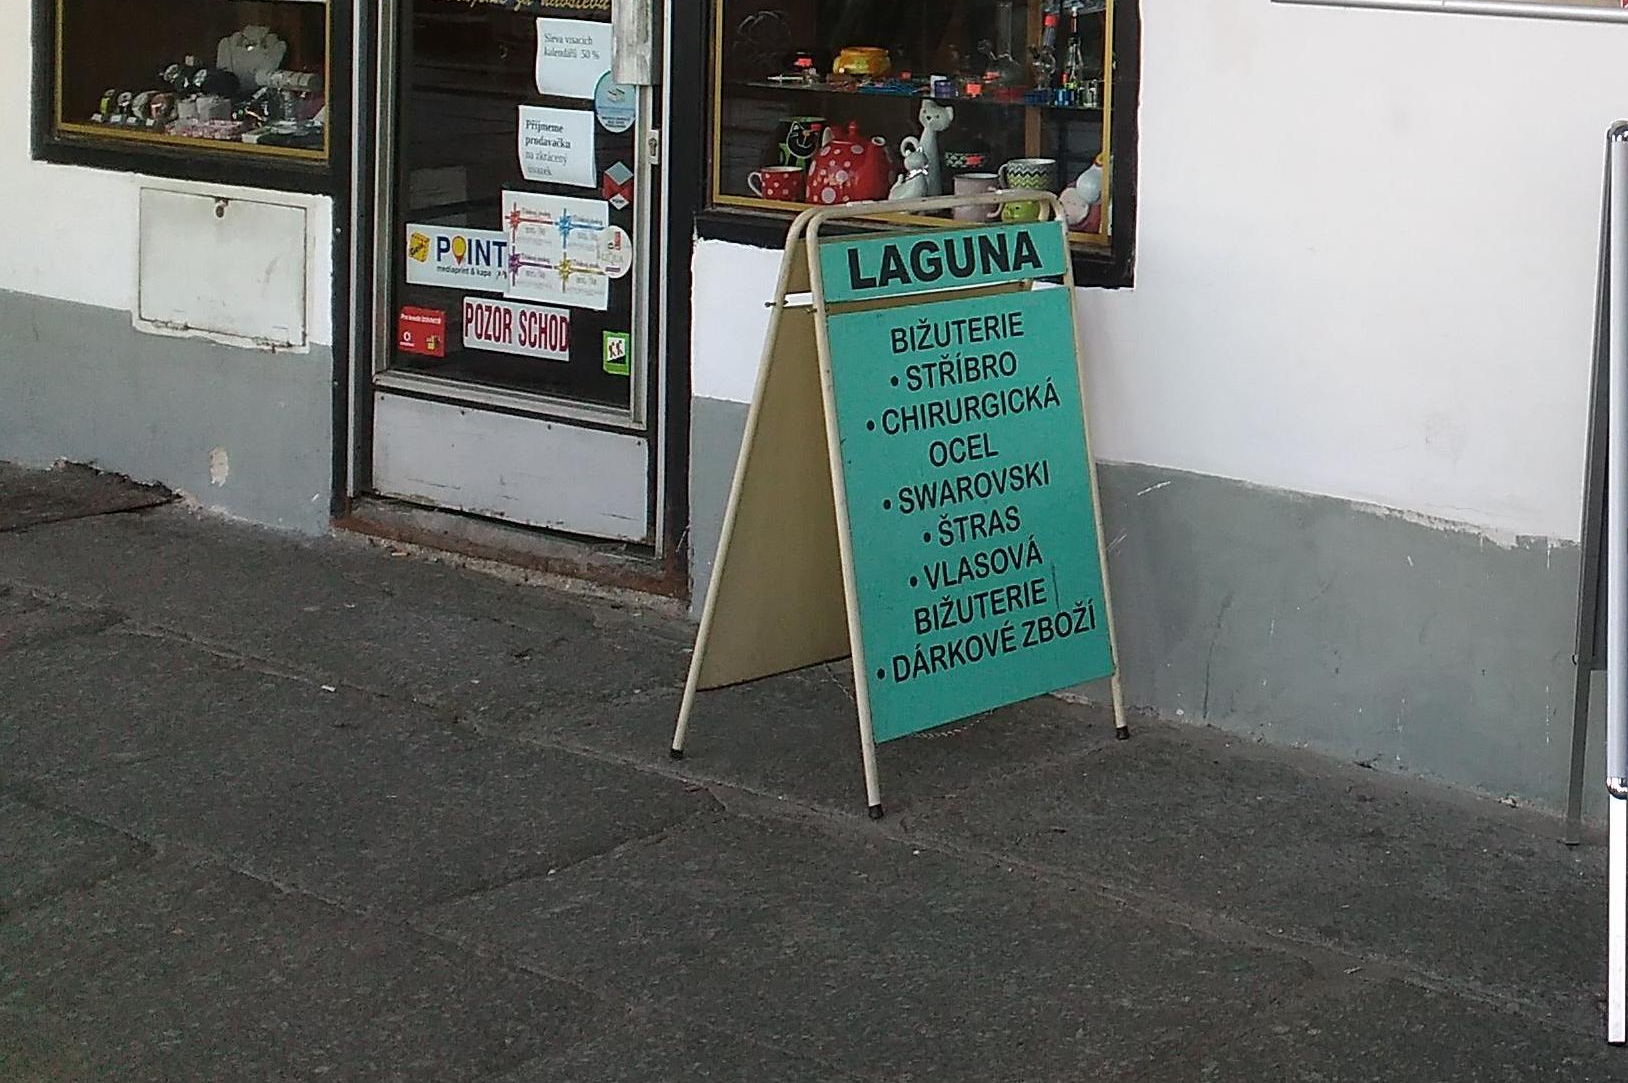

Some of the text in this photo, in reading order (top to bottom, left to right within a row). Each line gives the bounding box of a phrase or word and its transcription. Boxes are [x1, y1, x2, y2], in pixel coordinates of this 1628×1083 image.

[436, 235, 507, 268] POINT
[847, 231, 1042, 290] LAGUNA
[464, 302, 569, 352] POZOR SCHOD
[891, 312, 1024, 354] BIŽUTERIE
[905, 351, 1017, 392] STŘÍBRO
[881, 376, 1060, 435] CHIRURGICKÁ
[928, 433, 998, 467] OCEL
[898, 459, 1049, 514] SWAROVSKI
[938, 505, 1020, 547] ŠTRAS
[923, 534, 1043, 591] VLASOVÁ
[914, 577, 1046, 635] BIŽUTERIE
[893, 602, 1097, 683] DÁRKOVÉ ZBOŽÍ
